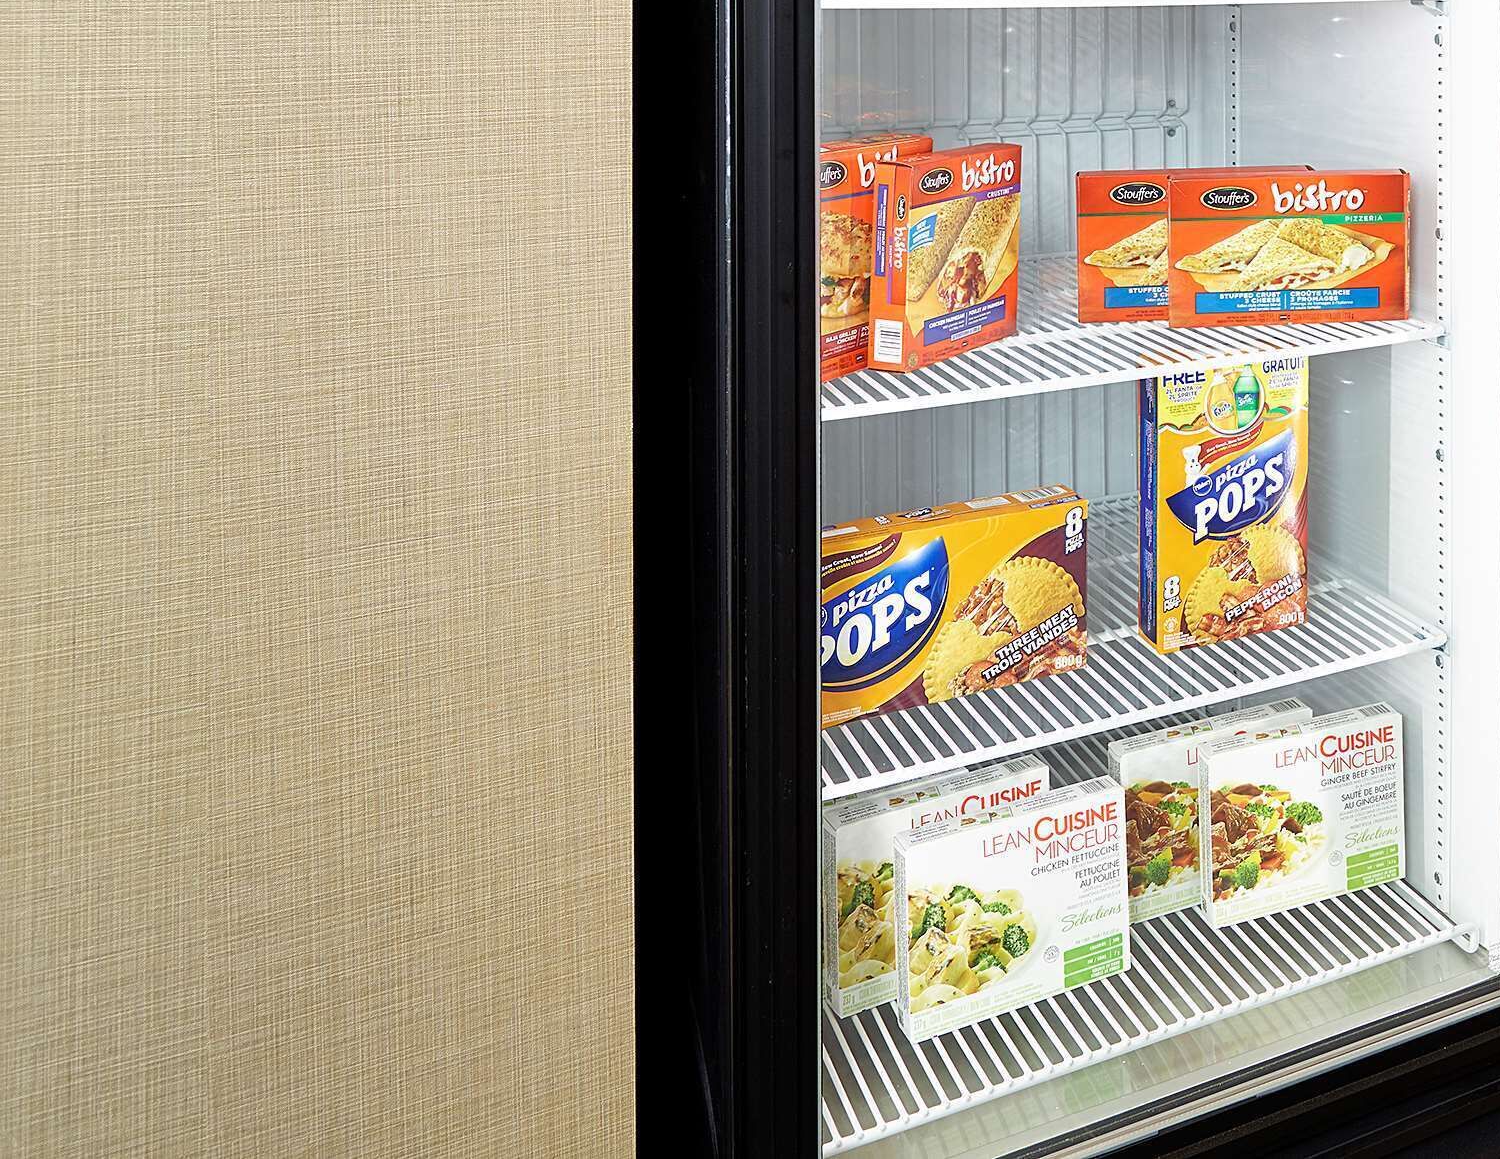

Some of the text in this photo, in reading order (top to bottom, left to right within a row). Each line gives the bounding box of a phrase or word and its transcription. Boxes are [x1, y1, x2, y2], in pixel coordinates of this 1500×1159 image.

[821, 166, 842, 184] uffer's
[923, 173, 951, 189] Stouffer's
[961, 153, 1015, 191] bistro
[1116, 188, 1160, 204] Stouffer's
[1206, 190, 1251, 206] Stouffer's
[1271, 178, 1366, 212] bistro
[1344, 215, 1383, 223] PIZZERIA
[894, 226, 907, 269] bistro
[1162, 371, 1206, 387] FREE
[1215, 454, 1259, 493] pizza
[1193, 452, 1284, 544] POPS
[1064, 505, 1084, 539] 8
[832, 574, 895, 627] pizza
[1163, 576, 1181, 600] 8
[1226, 575, 1292, 622] PEPPERONI
[1262, 579, 1303, 612] BACON
[981, 615, 1079, 682] TROIS VIANDES
[994, 604, 1076, 660] THREE MEAT
[1274, 725, 1394, 769] LEAN CUISINE
[1321, 745, 1395, 776] MINCEUR
[1320, 762, 1396, 787] GINGER BEEF STIRFRY
[1363, 787, 1373, 797] DE
[1374, 780, 1397, 793] BOEUF
[1343, 790, 1397, 810] AU GINGEMBRE
[982, 801, 1118, 858] LEAN CUISINE
[1035, 823, 1119, 864] MINCEUR
[1031, 843, 1120, 877] CHICKEN FETTUCCINE
[1075, 859, 1120, 880] FETTUCCINE
[1079, 868, 1120, 889] AU POULET
